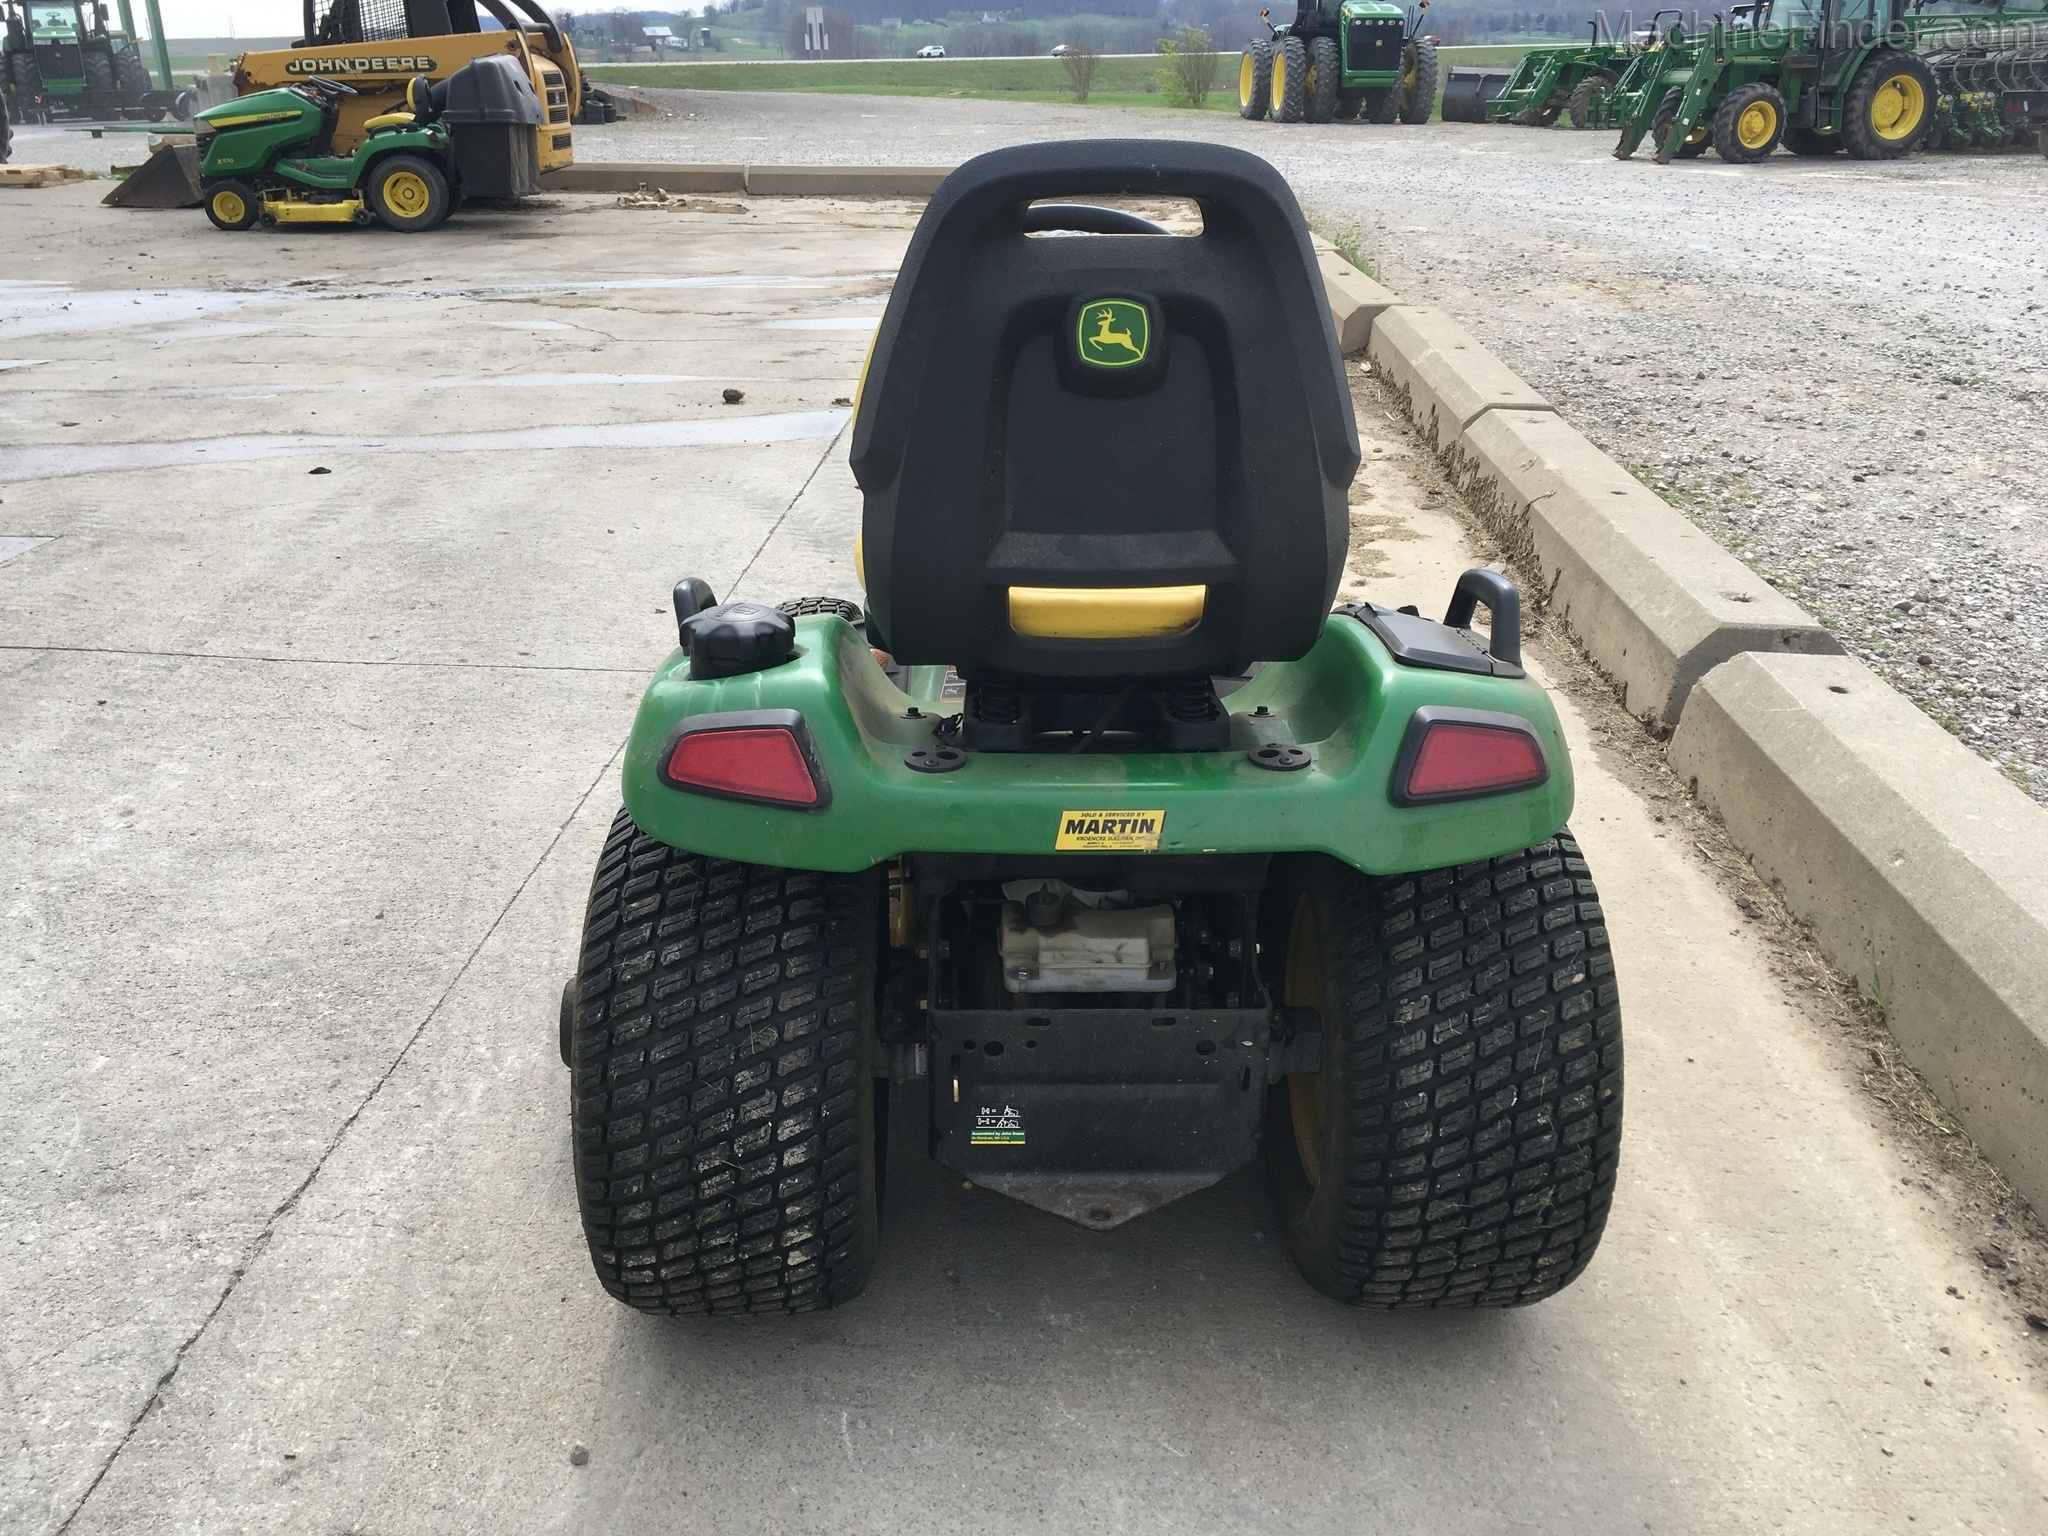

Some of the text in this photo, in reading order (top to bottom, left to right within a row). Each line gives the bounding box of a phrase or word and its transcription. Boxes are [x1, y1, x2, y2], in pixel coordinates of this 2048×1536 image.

[289, 56, 430, 72] JOHN DEERE
[1065, 819, 1155, 834] MARTIN
